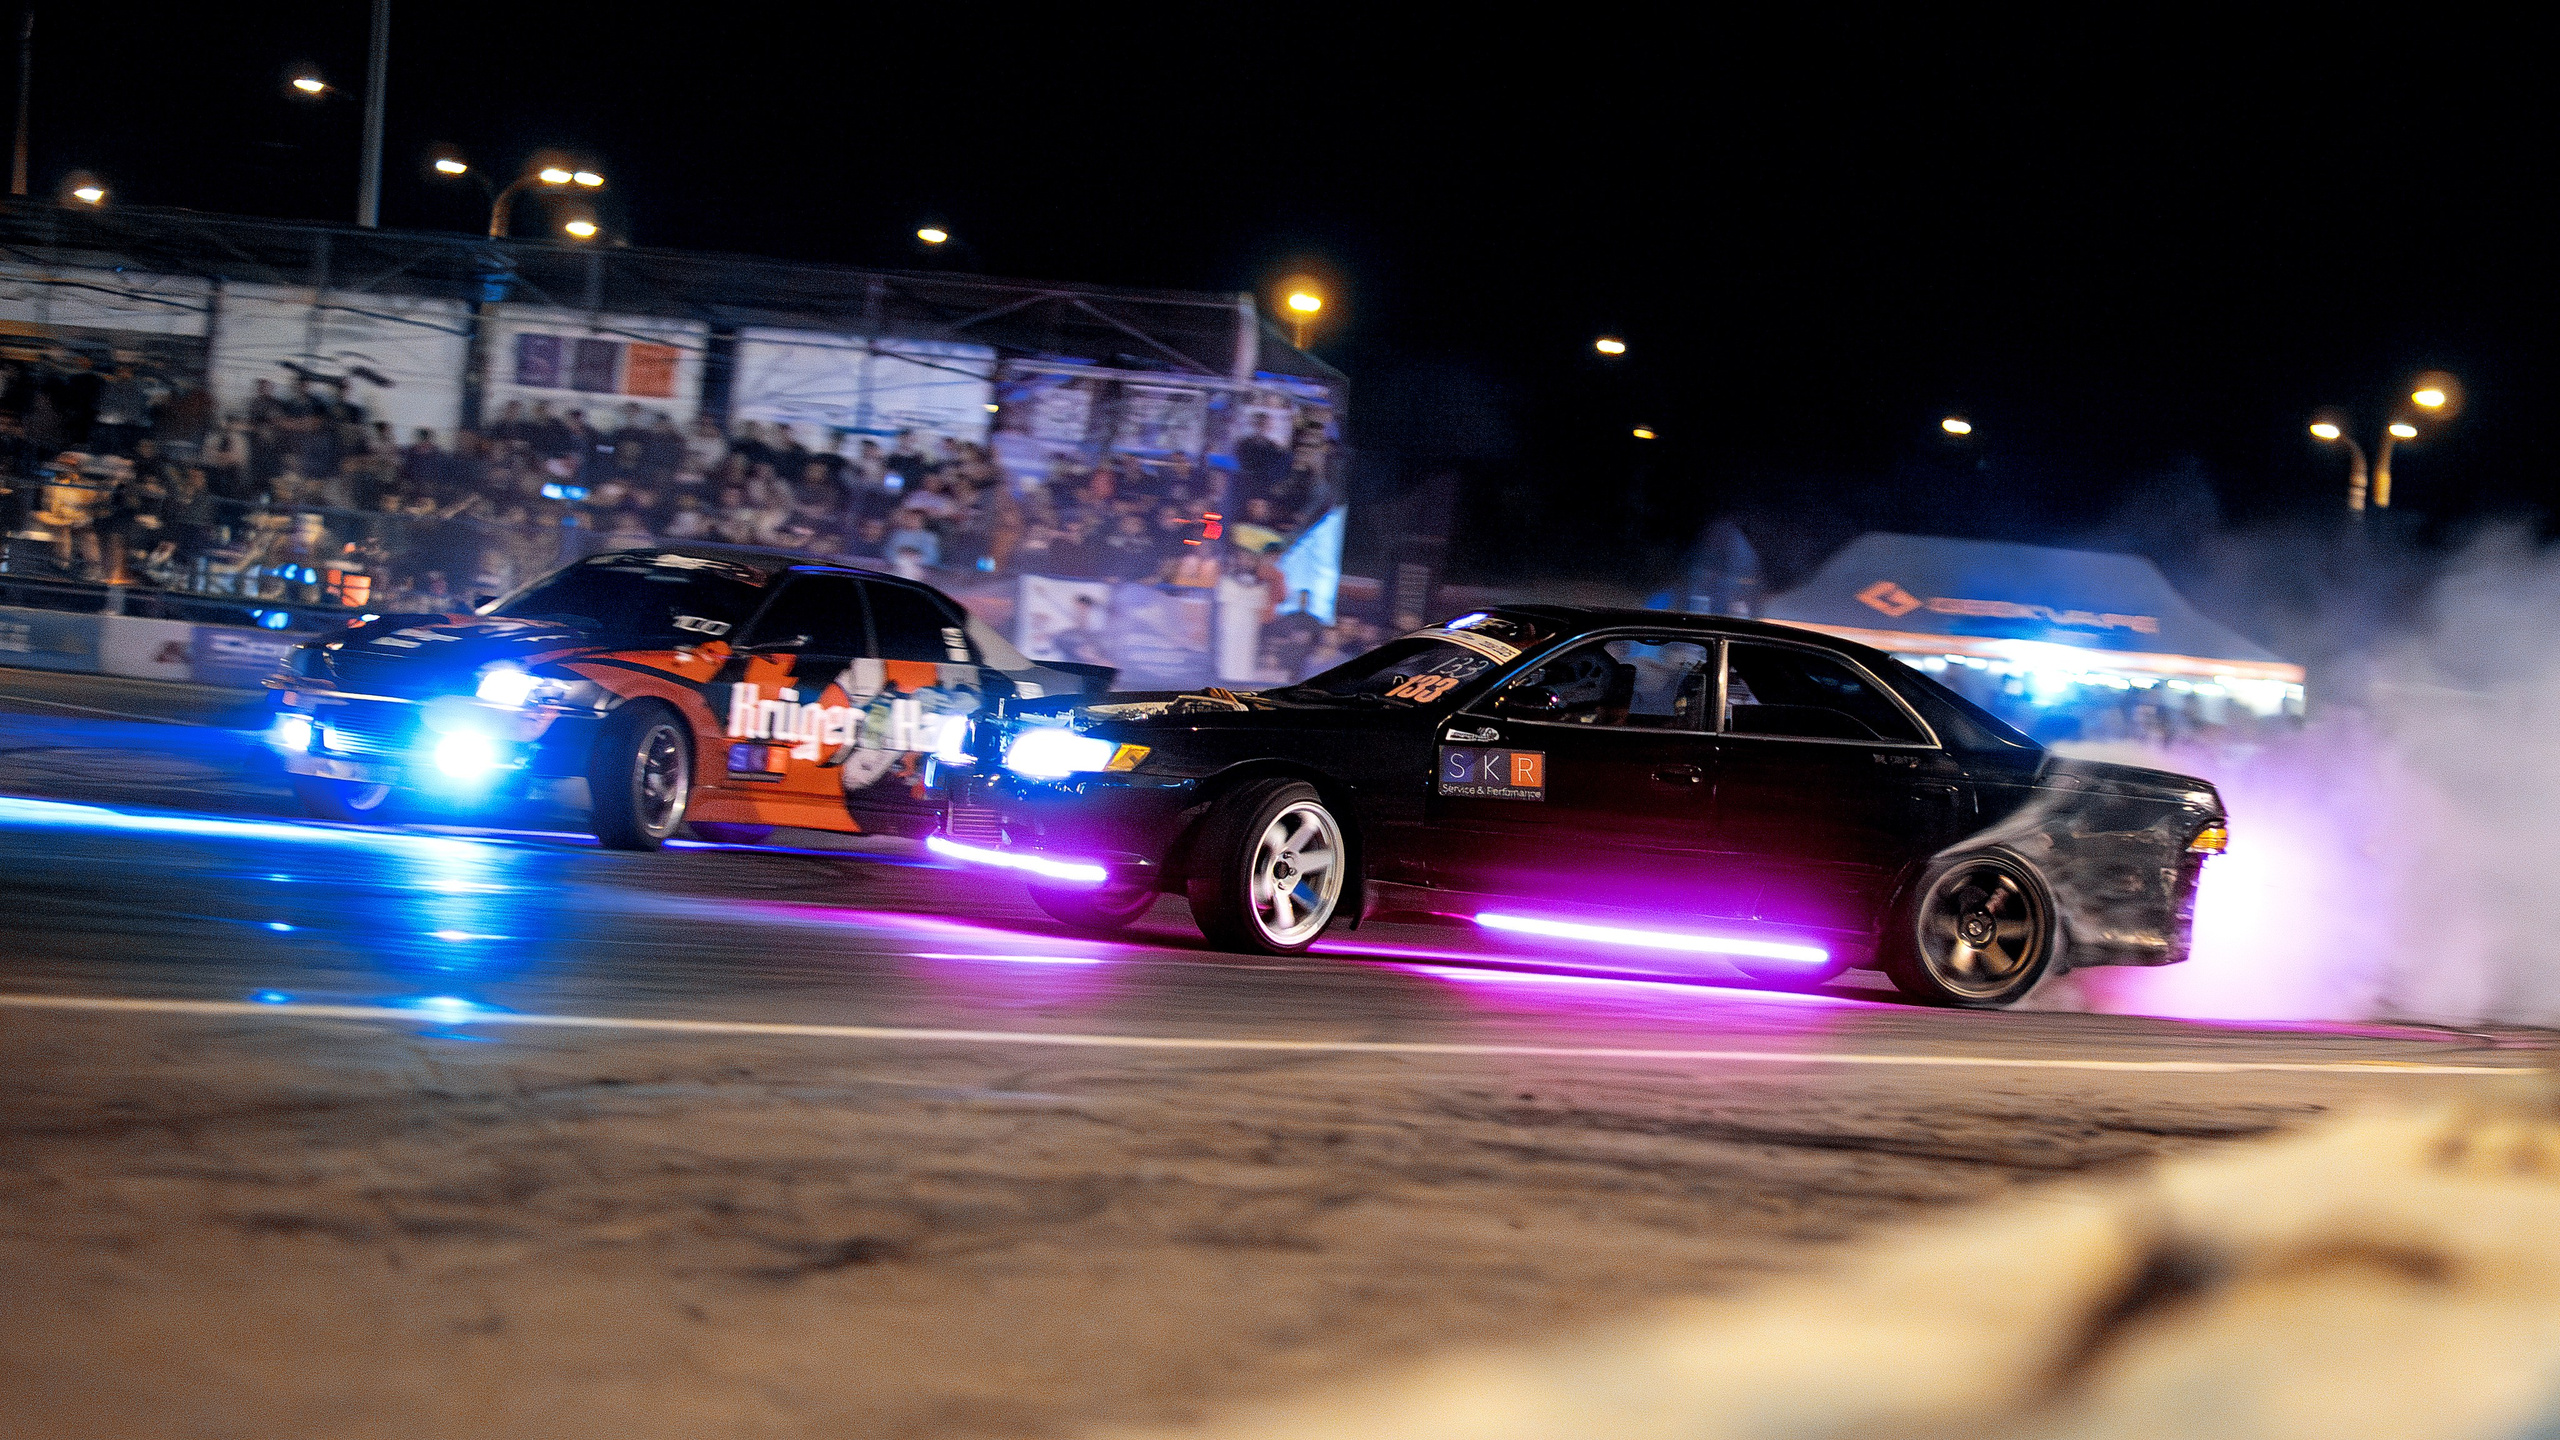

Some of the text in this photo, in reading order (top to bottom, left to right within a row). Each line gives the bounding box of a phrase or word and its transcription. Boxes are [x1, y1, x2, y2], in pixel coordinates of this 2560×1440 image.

[1427, 657, 1489, 678] 133
[1384, 674, 1460, 703] 133
[728, 682, 867, 761] Krüger
[1442, 783, 1475, 795] Service
[1476, 786, 1485, 795] &
